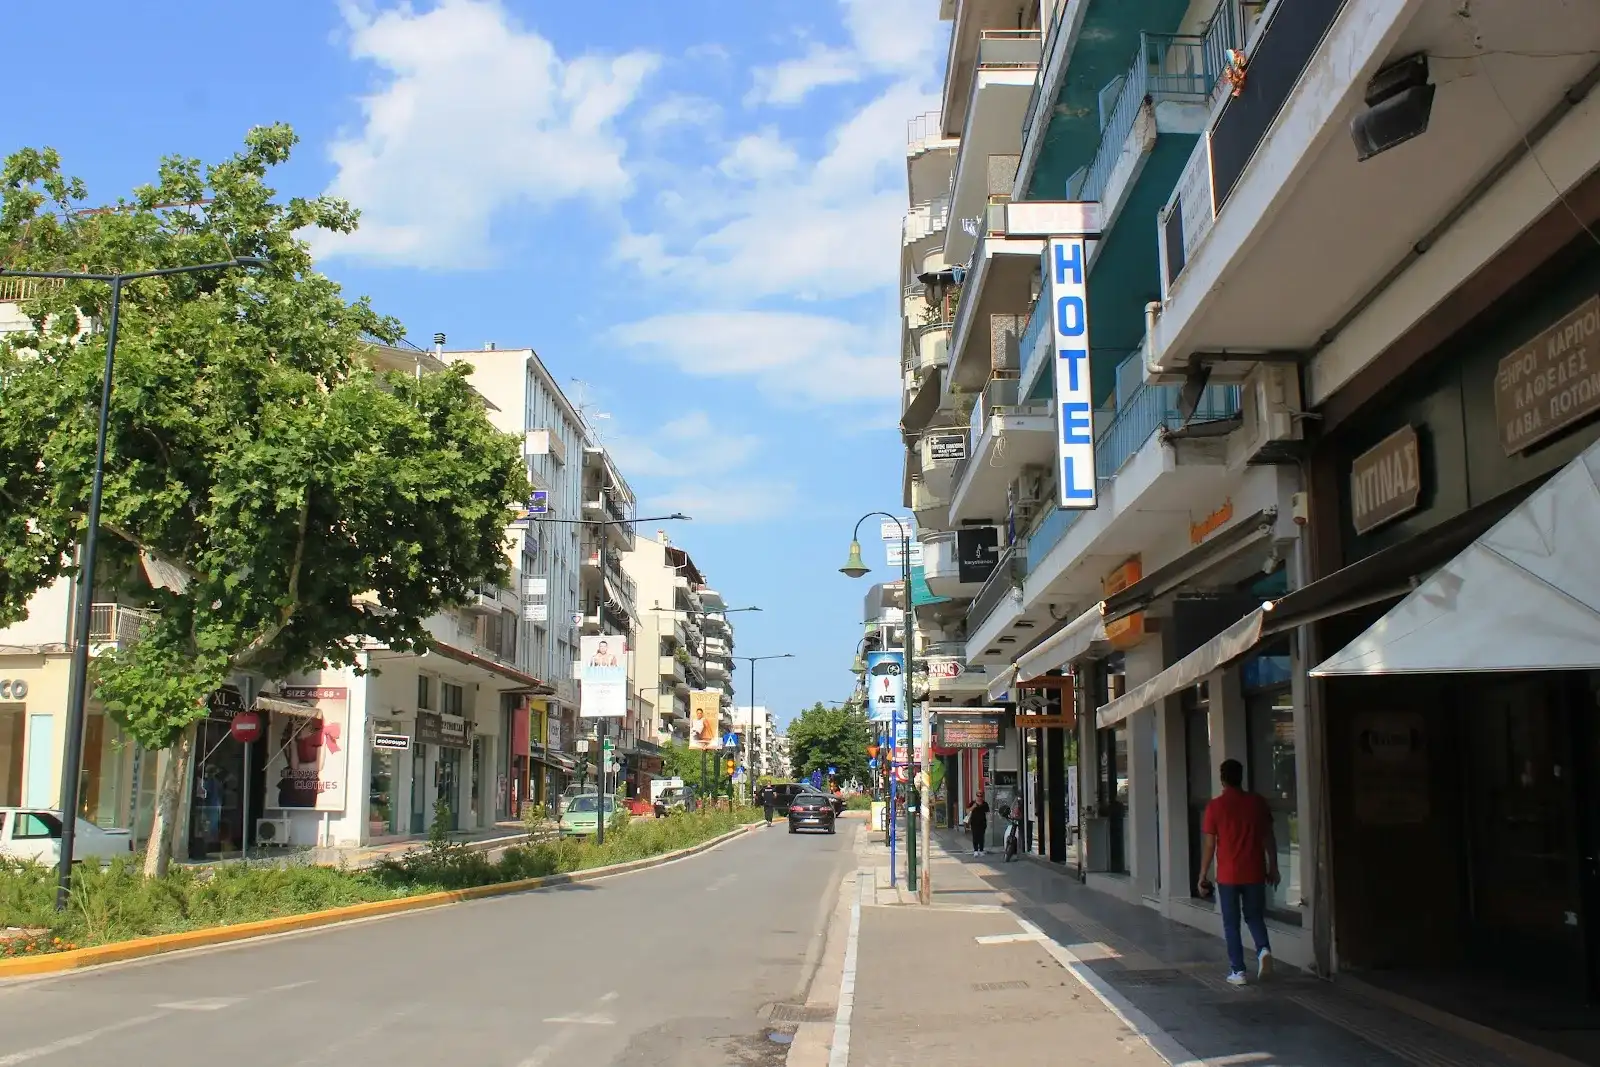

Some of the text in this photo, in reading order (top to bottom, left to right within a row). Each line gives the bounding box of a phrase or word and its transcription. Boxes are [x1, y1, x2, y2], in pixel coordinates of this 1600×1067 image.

[1054, 244, 1093, 499] HOTEL
[1500, 349, 1537, 391] ΞΗΡΟΙ
[1505, 407, 1542, 444] ΚΑΒΑ
[1355, 440, 1417, 518] ΝΤΙΝΑΣ
[213, 692, 229, 706] XL
[294, 780, 338, 791] CLOTHES
